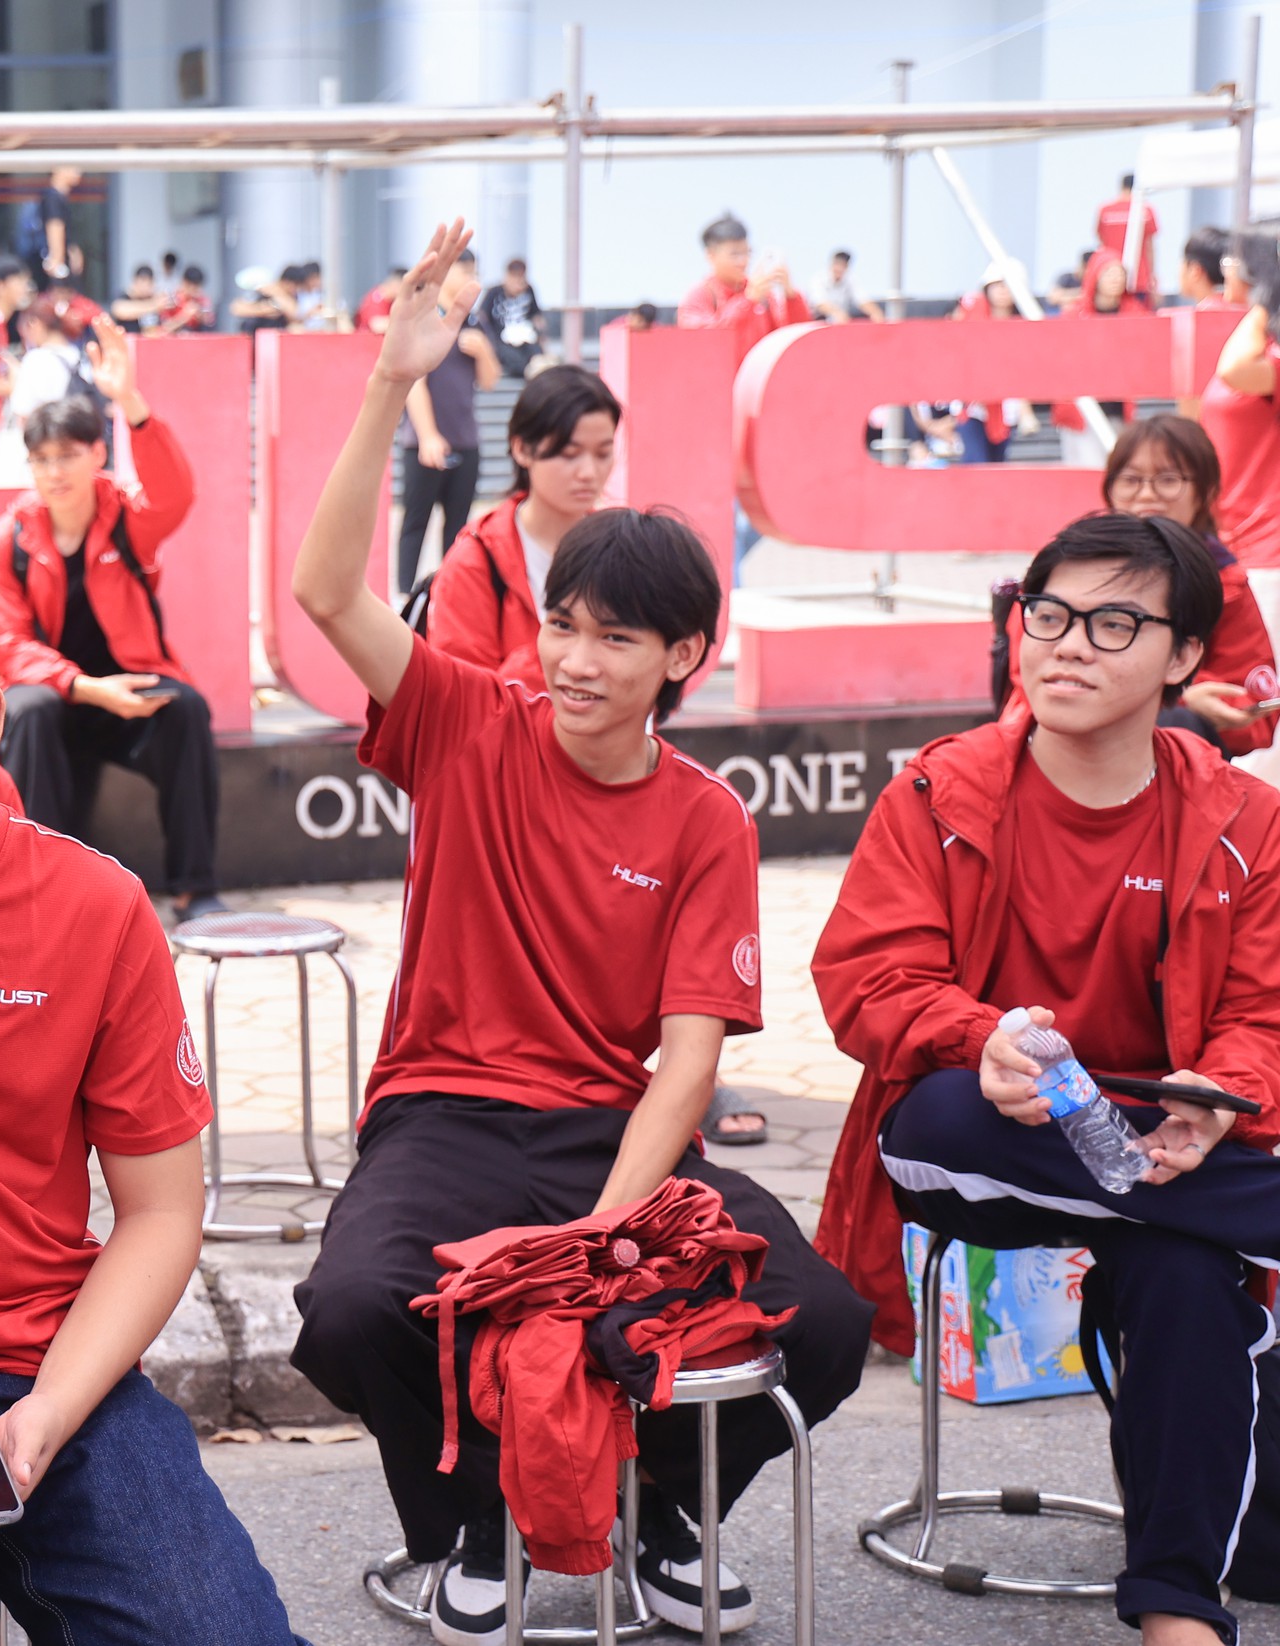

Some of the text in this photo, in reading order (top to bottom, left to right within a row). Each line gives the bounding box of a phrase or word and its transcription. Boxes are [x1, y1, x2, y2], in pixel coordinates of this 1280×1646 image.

[296, 774, 411, 840] ON
[715, 750, 867, 817] ONE
[611, 863, 663, 892] HUST
[1124, 874, 1164, 892] HUS
